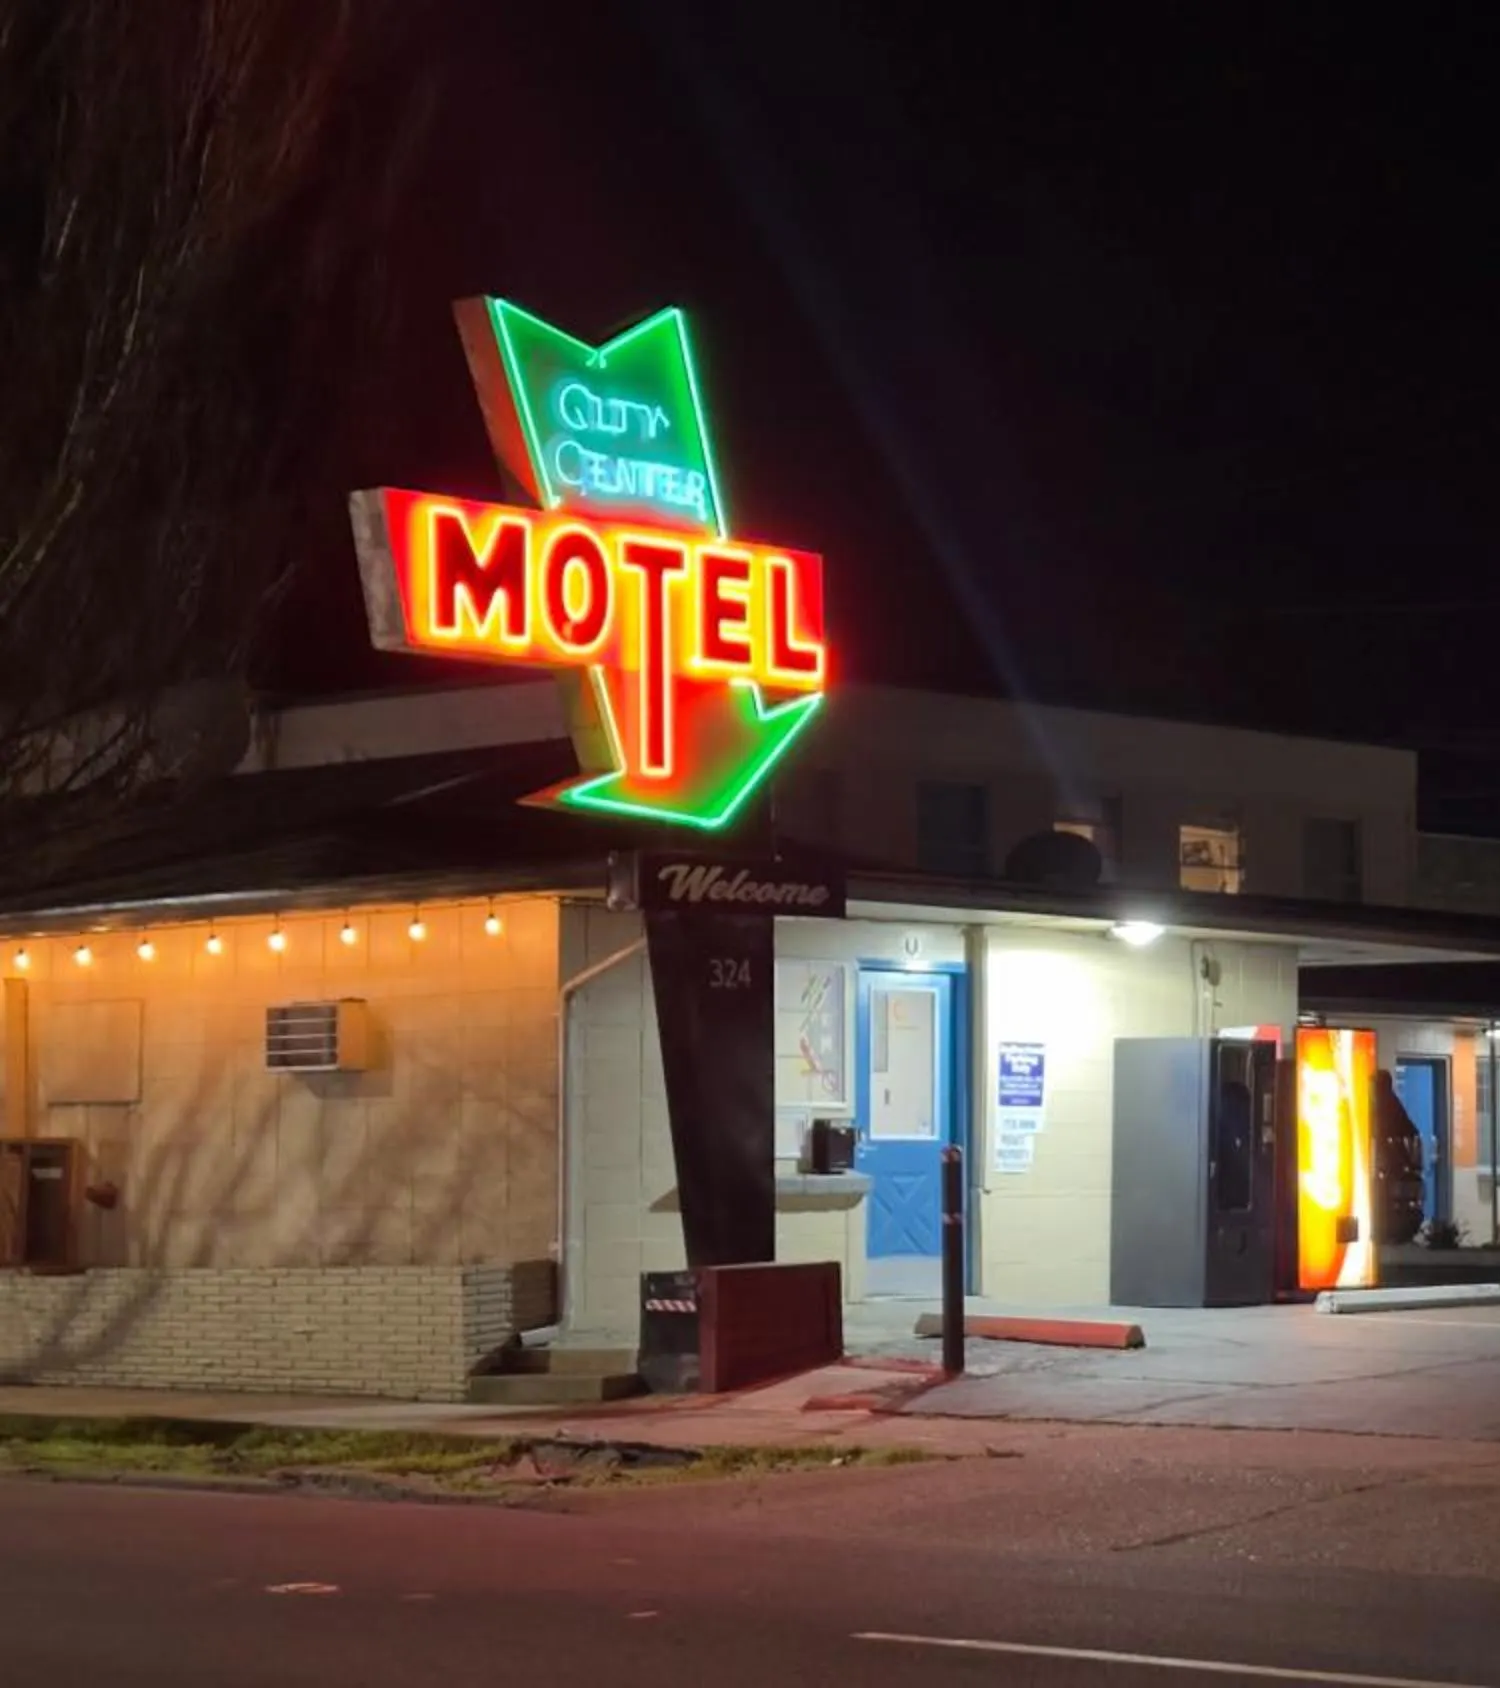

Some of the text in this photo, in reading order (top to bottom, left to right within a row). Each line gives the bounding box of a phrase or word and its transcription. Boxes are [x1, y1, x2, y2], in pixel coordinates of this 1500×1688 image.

[559, 383, 671, 440] CITY
[555, 440, 707, 522] CENTER
[429, 505, 825, 776] MOTEL
[658, 864, 830, 905] Welcome
[709, 958, 751, 988] 324
